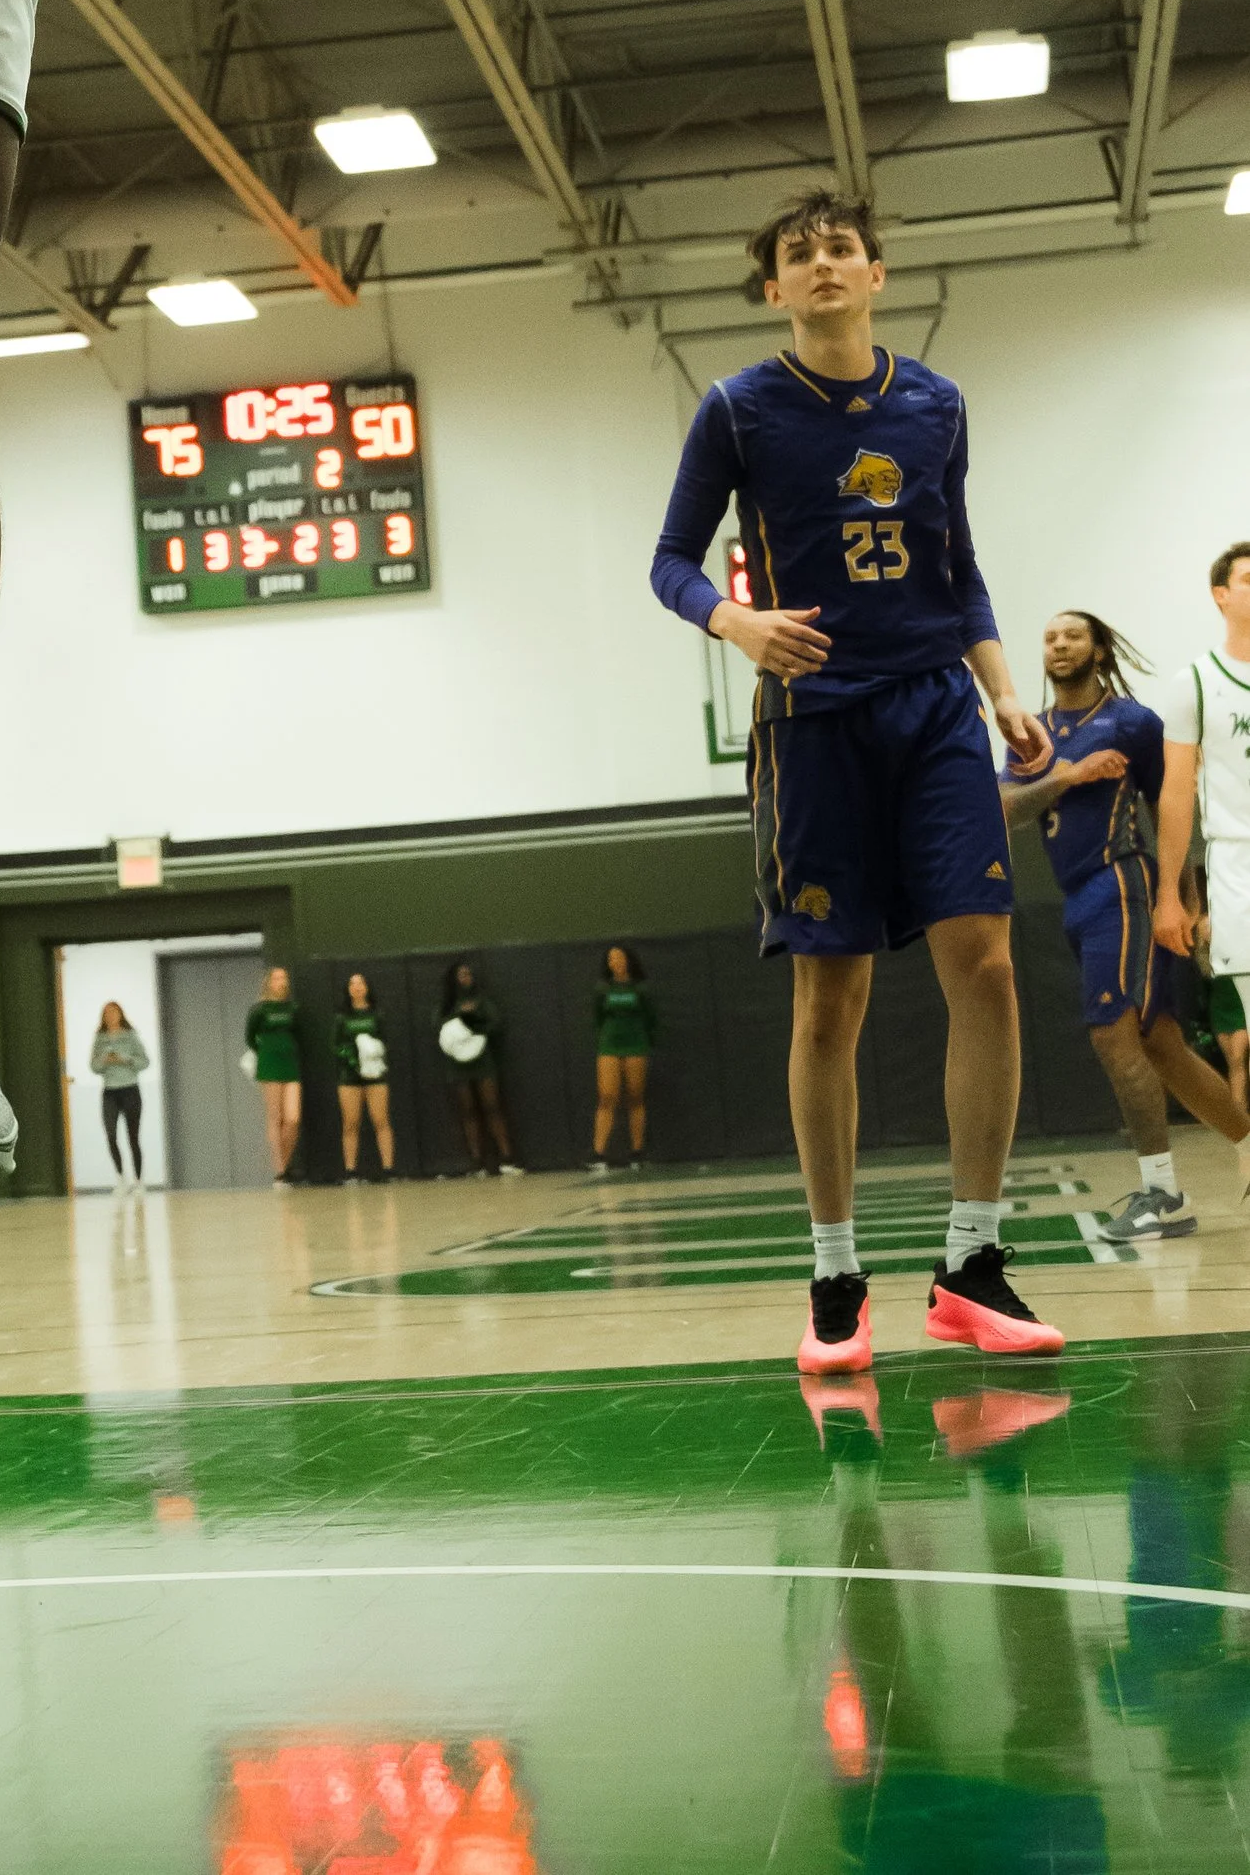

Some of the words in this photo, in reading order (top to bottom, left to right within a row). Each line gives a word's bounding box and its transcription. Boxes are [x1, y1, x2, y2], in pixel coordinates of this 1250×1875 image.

[224, 382, 335, 443] 10:25
[351, 403, 416, 460] 50
[143, 423, 204, 477] 75
[314, 447, 343, 490] 2
[166, 536, 185, 574] 1
[204, 529, 230, 573] 3
[331, 518, 360, 562] 3
[385, 513, 414, 557] 3
[842, 520, 910, 582] 23
